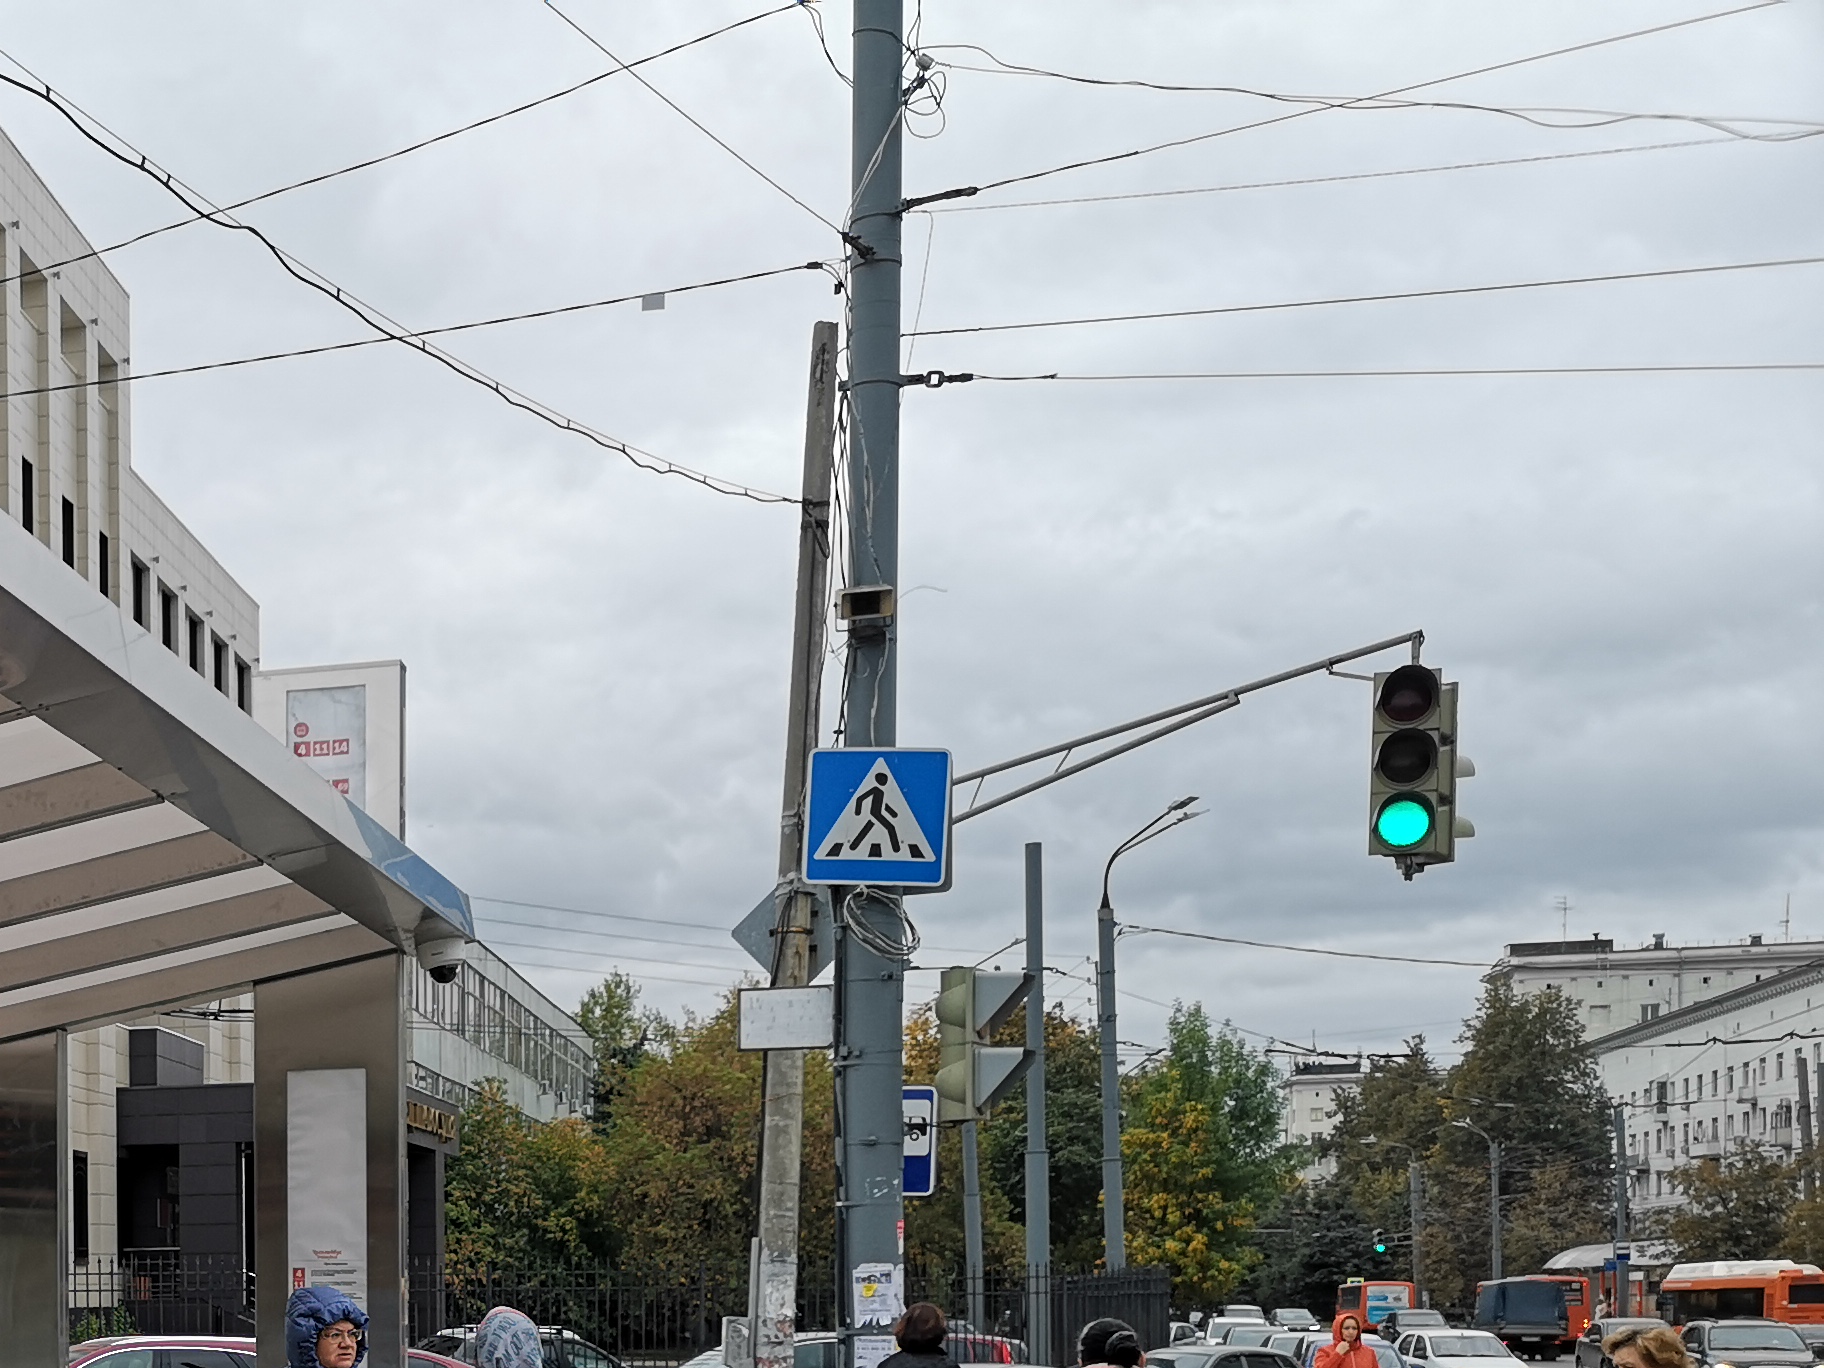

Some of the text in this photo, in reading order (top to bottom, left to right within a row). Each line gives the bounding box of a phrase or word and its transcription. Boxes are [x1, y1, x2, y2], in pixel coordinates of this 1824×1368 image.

[297, 740, 348, 755] 4 11 14
